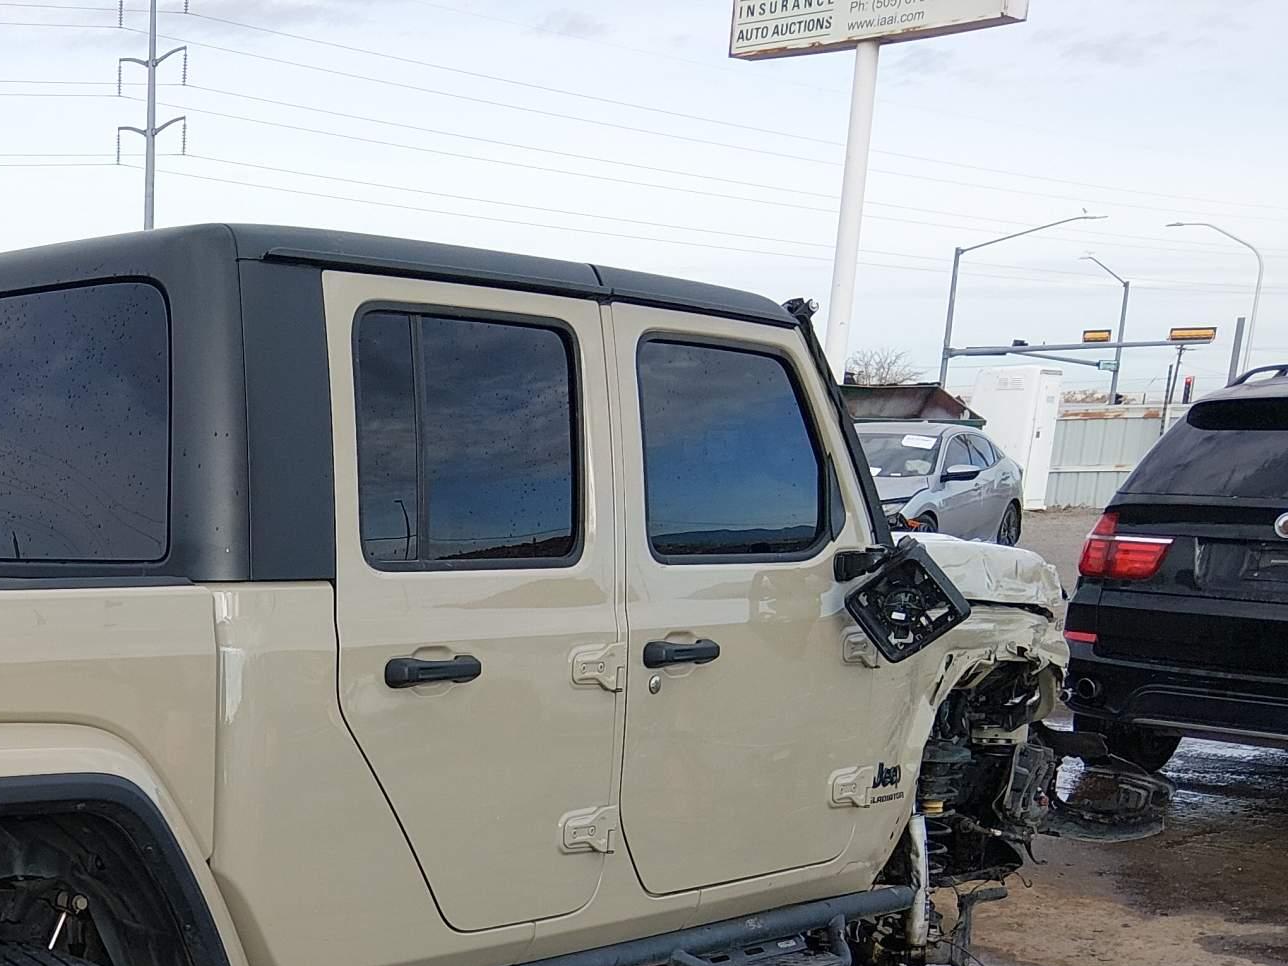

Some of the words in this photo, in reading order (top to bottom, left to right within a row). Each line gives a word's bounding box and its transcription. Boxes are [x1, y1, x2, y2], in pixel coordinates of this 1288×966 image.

[736, 25, 769, 42] AUTO
[771, 16, 833, 38] AUCTIONS
[847, 10, 925, 31] www.iaai.com
[872, 762, 902, 789] Jeep
